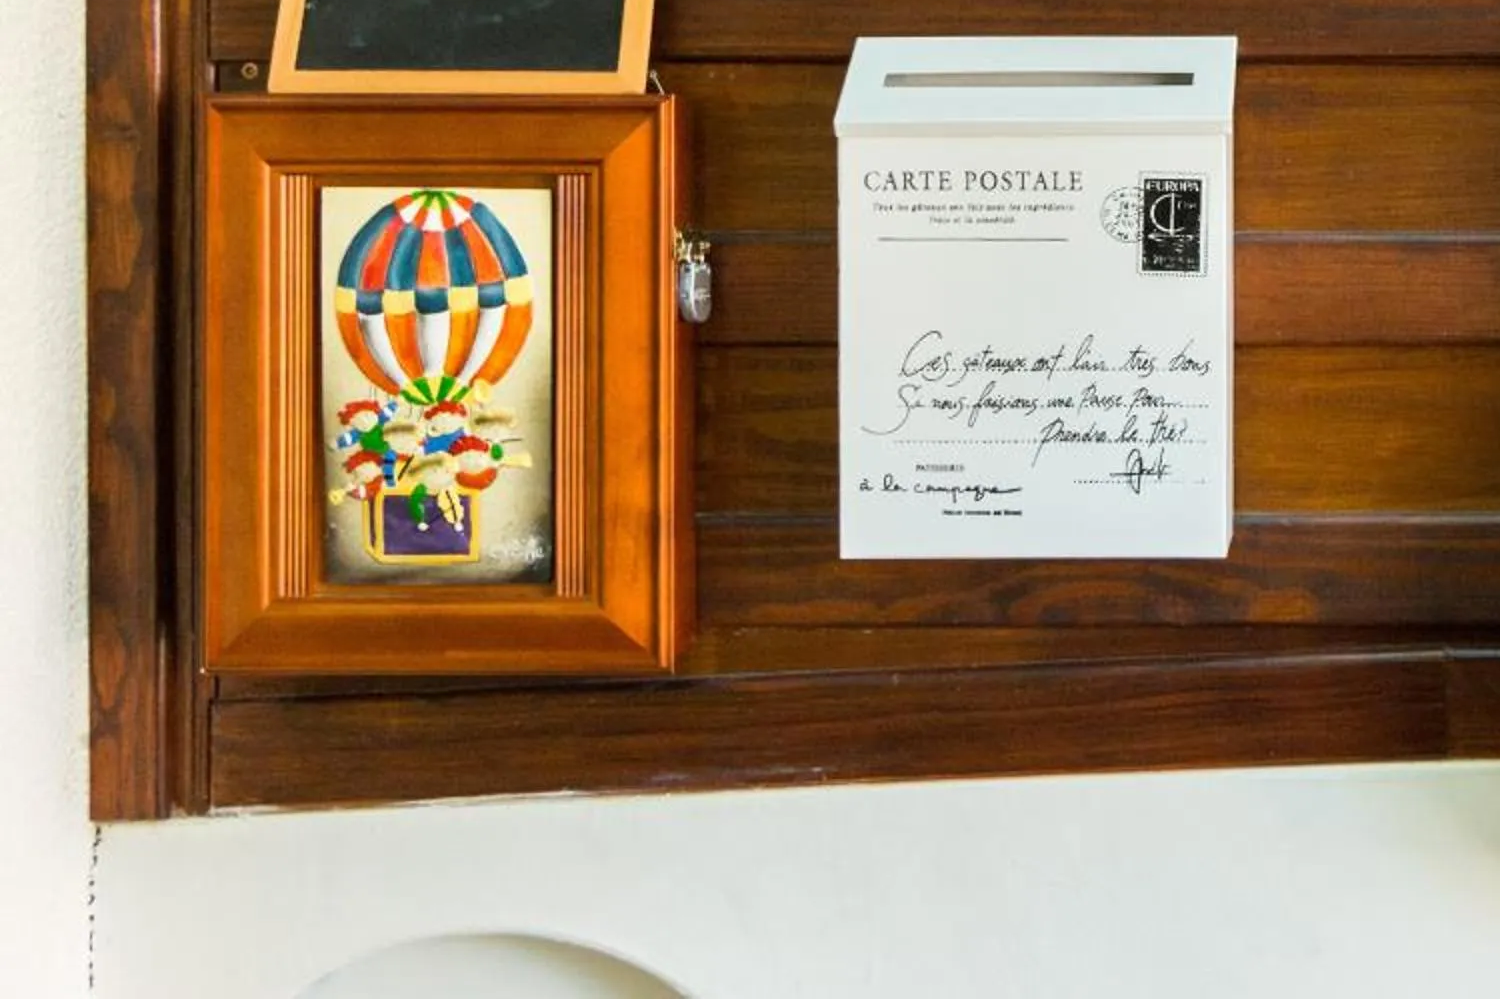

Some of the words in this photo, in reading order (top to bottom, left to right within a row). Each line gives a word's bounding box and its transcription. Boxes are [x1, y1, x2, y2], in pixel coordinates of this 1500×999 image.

[864, 170, 952, 191] CARTE
[964, 170, 1084, 191] POSTALE
[881, 473, 907, 492] la
